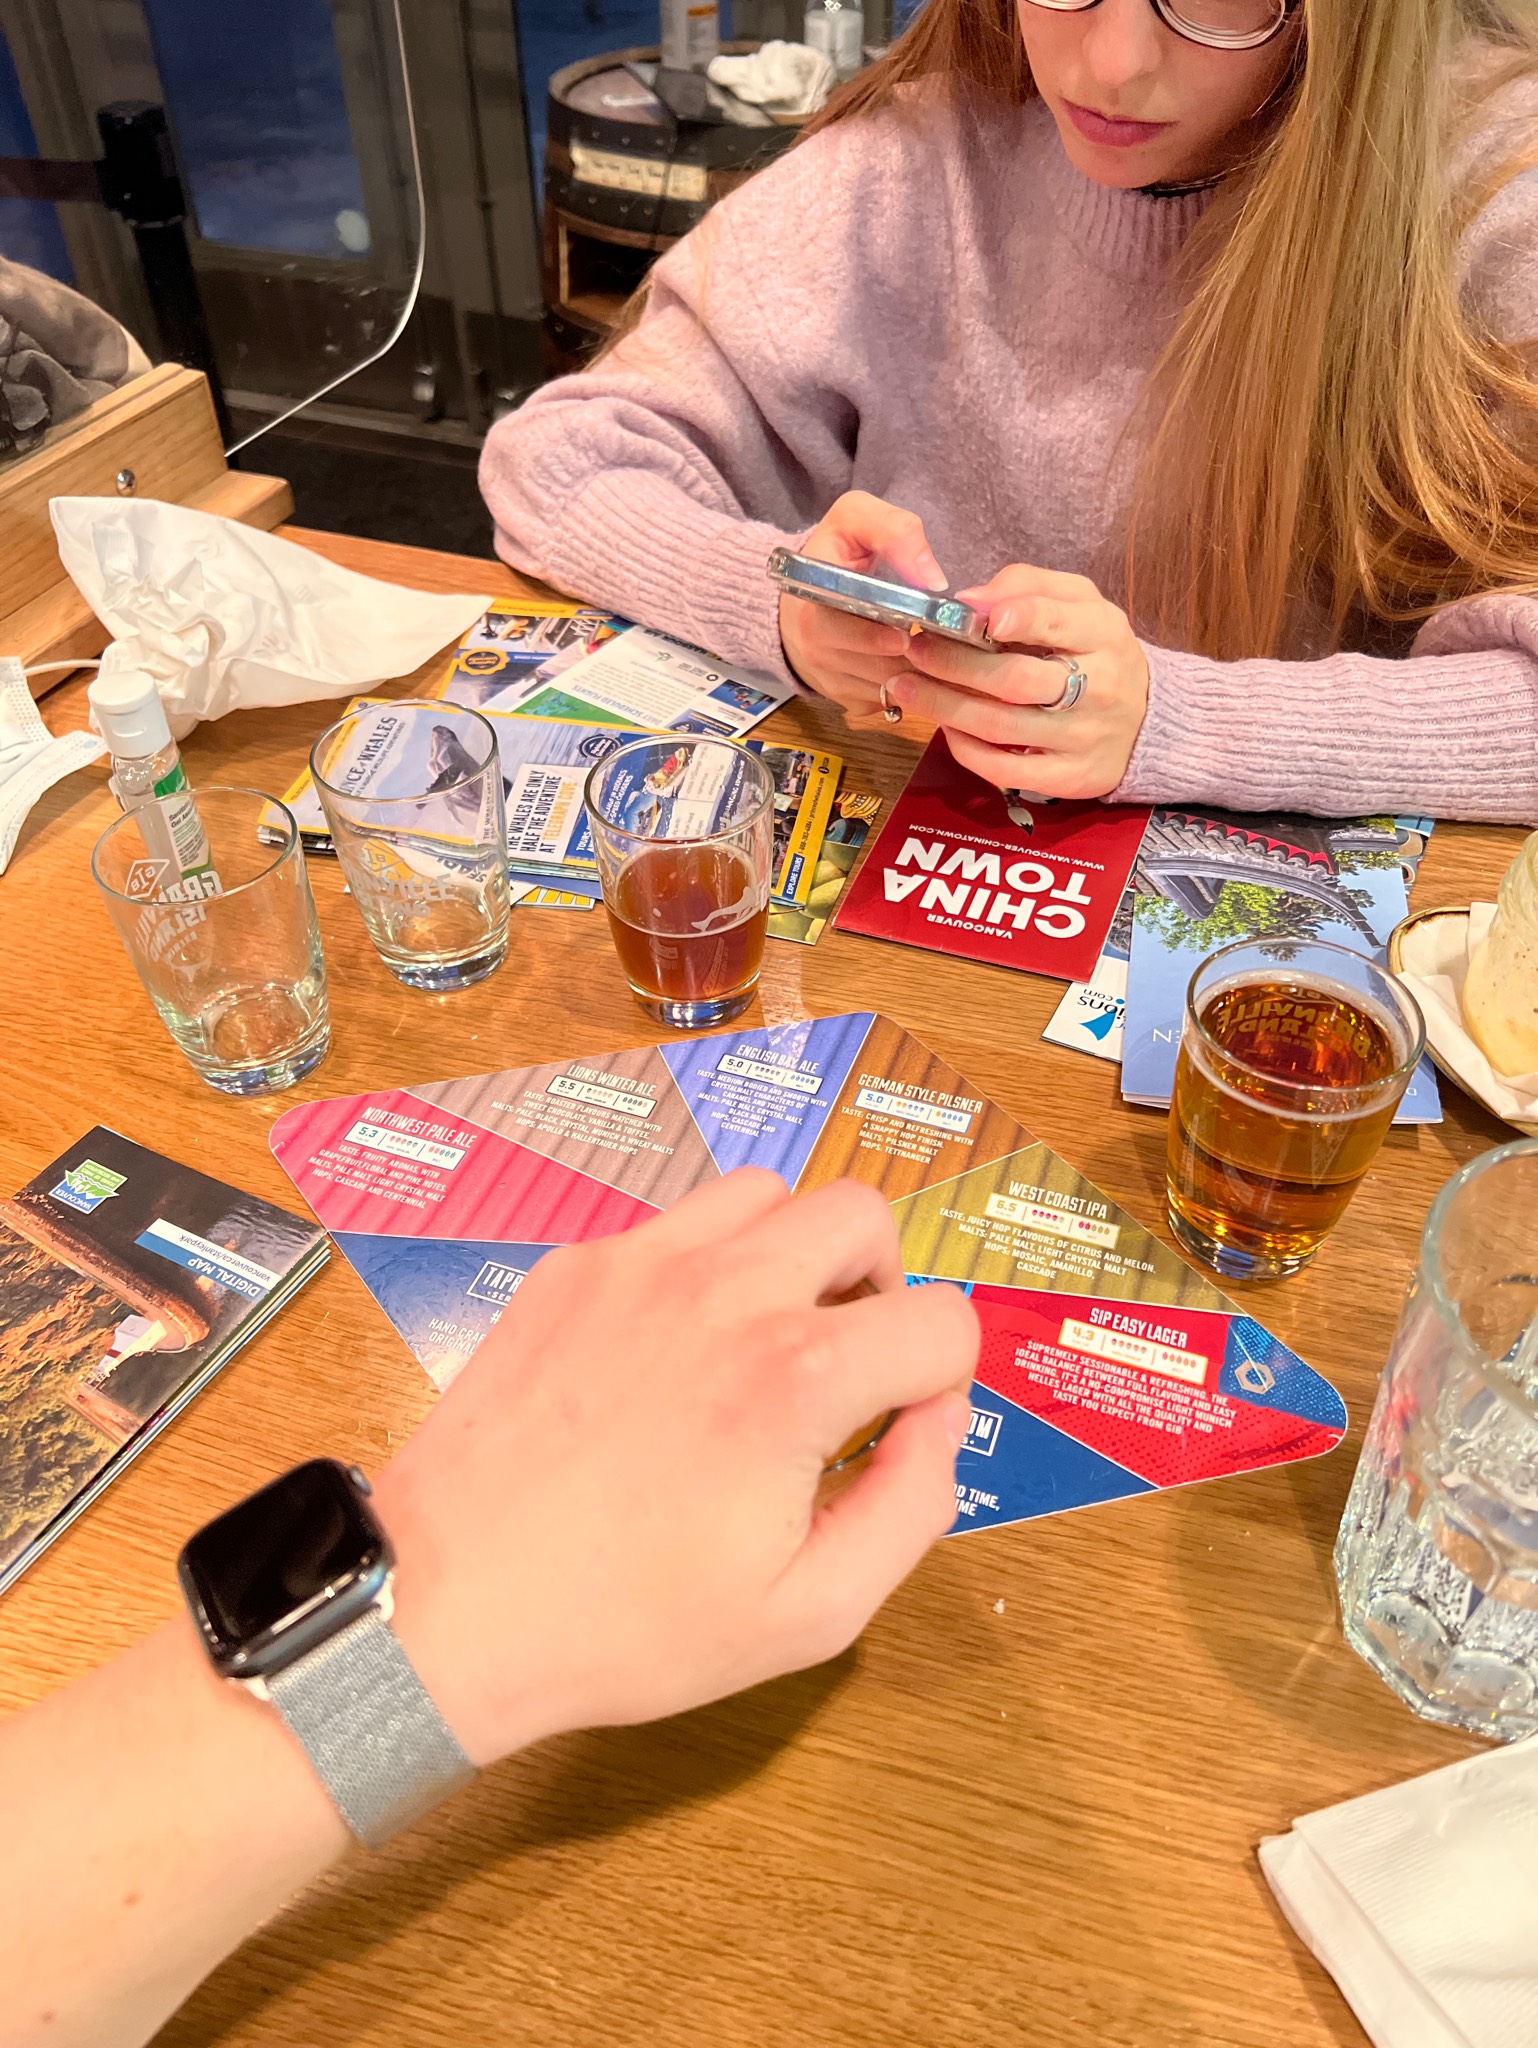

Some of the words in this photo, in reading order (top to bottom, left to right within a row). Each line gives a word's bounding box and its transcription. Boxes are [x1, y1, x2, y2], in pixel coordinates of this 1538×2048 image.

[357, 717, 398, 762] WHALES
[526, 770, 545, 790] ONLY
[521, 788, 537, 804] ARE
[535, 776, 562, 815] ADVENTURE
[509, 804, 529, 833] WHALES
[532, 815, 547, 831] THE
[542, 801, 569, 841] TELEGRAPH
[520, 832, 538, 852] HALF
[540, 843, 556, 854] AT
[909, 824, 1104, 871] WWW.VANCOUVER-CHINATOWN.COM
[786, 871, 798, 895] EXPLORE
[792, 856, 803, 872] TOURS
[895, 837, 1092, 905] TOWN
[883, 868, 1086, 939] CHINA
[927, 913, 1012, 939] VANCOUVER
[727, 1058, 744, 1068] 5.0
[736, 1044, 779, 1064] ENGLISH
[778, 1054, 799, 1069] BAY
[798, 1059, 819, 1073] ALE
[558, 1080, 576, 1091] 5.5
[567, 1064, 599, 1082] LIONS
[597, 1072, 637, 1091] WINTER
[633, 1082, 657, 1097] ALE
[858, 1073, 906, 1095] GERMAN
[904, 1085, 938, 1103] STYLE
[937, 1092, 983, 1114] PILSNER
[866, 1093, 884, 1103] 5.0
[358, 1127, 378, 1138] 5.3
[361, 1106, 430, 1136] NORTHWEST
[427, 1124, 457, 1143] PALE
[451, 1129, 478, 1149] ALE
[841, 1106, 864, 1118] TASTE:
[866, 1113, 888, 1123] CRISP
[889, 1119, 905, 1129] AND
[906, 1123, 952, 1141] REFRESHING
[954, 1136, 974, 1146] WITH
[870, 1123, 899, 1136] SNAPPY
[900, 1132, 916, 1141] HOP
[917, 1136, 944, 1148] FINISH.
[859, 1130, 883, 1142] MALTS:
[885, 1137, 917, 1151] PILSNER
[918, 1145, 938, 1156] MALT
[860, 1140, 881, 1151] HOPS:
[884, 1146, 931, 1164] TETTNANGER
[338, 1144, 359, 1157] TASTE:
[361, 1151, 388, 1164] FRUITY
[421, 1168, 440, 1179] WITH
[312, 1168, 333, 1180] HOPS:
[335, 1175, 367, 1192] CASCADE
[369, 1185, 382, 1196] AND
[383, 1190, 427, 1209] CENTENNIAL
[334, 1164, 352, 1176] PALE
[373, 1176, 392, 1188] LIGHT
[394, 1183, 425, 1198] CRYSTAL
[426, 1192, 446, 1203] MALT
[390, 1170, 404, 1181] AND
[405, 1174, 422, 1185] PINE
[423, 1179, 447, 1193] NOTES.
[54, 1188, 92, 1210] VANCOUVER
[996, 1200, 1017, 1212] 6.5
[1009, 1181, 1046, 1203] WEST
[1044, 1192, 1087, 1214] COAST
[1085, 1202, 1108, 1219] IPA
[939, 1207, 965, 1221] TASTE:
[967, 1215, 992, 1227] JUICY
[992, 1222, 1011, 1233] HOP
[1012, 1227, 1055, 1246] FLAVOURS
[1057, 1239, 1069, 1249] OF
[1071, 1243, 1102, 1259] CITRUS
[1103, 1252, 1122, 1264] AND
[1123, 1258, 1156, 1274] MELON.
[958, 1224, 988, 1239] MALTS:
[989, 1231, 1010, 1244] PALE
[1013, 1238, 1036, 1252] MALT,
[1037, 1246, 1064, 1259] LIGHT
[1065, 1252, 1101, 1270] CRYSTAL
[1103, 1263, 1127, 1276] MALT
[179, 1234, 271, 1282] vancouver.ca/stanleypark
[187, 1258, 219, 1276] MAP
[984, 1241, 1010, 1256] HOPS:
[1012, 1250, 1047, 1266] MOSAIC,
[1049, 1259, 1096, 1280] AMARILLO,
[1016, 1261, 1056, 1279] CASCADE
[216, 1270, 261, 1297] DIGITAL
[483, 1267, 525, 1294] TAPR
[492, 1291, 512, 1302] SER
[428, 1319, 457, 1335] HAND
[458, 1327, 487, 1344] CRAF
[1073, 1325, 1095, 1341] 4.3
[1089, 1307, 1113, 1326] SIP
[1111, 1314, 1146, 1337] EASY
[1147, 1324, 1187, 1348] LAGER
[429, 1331, 476, 1355] ORIGINAL
[1015, 1348, 1041, 1363] IDEAL
[1042, 1355, 1081, 1374] BALANCE
[1083, 1366, 1125, 1386] BETWEEN
[1126, 1379, 1148, 1393] FULL
[1150, 1387, 1191, 1404] FLAVOUR
[1192, 1398, 1212, 1412] AND
[1213, 1406, 1237, 1419] EASY
[1027, 1341, 1078, 1362] SUPREMELY
[1079, 1355, 1139, 1380] SESSIONABLE
[1140, 1373, 1147, 1382] &
[1149, 1376, 1209, 1400] REFRESHING.
[1211, 1393, 1228, 1406] THE
[1014, 1357, 1057, 1378] DRINKING.
[1061, 1371, 1078, 1384] IT'S
[1080, 1378, 1087, 1387] A
[1088, 1380, 1165, 1409] NO-COMPROMISE
[1167, 1402, 1193, 1417] LIGHT
[1194, 1410, 1232, 1428] MUNICH
[1028, 1372, 1060, 1388] HELLES
[1062, 1382, 1090, 1398] LAGER
[1092, 1391, 1116, 1404] WITH
[1117, 1397, 1134, 1409] ALL
[1136, 1404, 1153, 1416] THE
[1154, 1409, 1192, 1428] QUALITY
[1193, 1421, 1213, 1433] AND
[1053, 1390, 1079, 1405] TASTE
[1081, 1397, 1100, 1411] YOU
[1101, 1402, 1135, 1422] EXPECT
[1137, 1414, 1164, 1430] FROM
[1166, 1421, 1182, 1435] GIB
[969, 1488, 1000, 1511] TIME,
